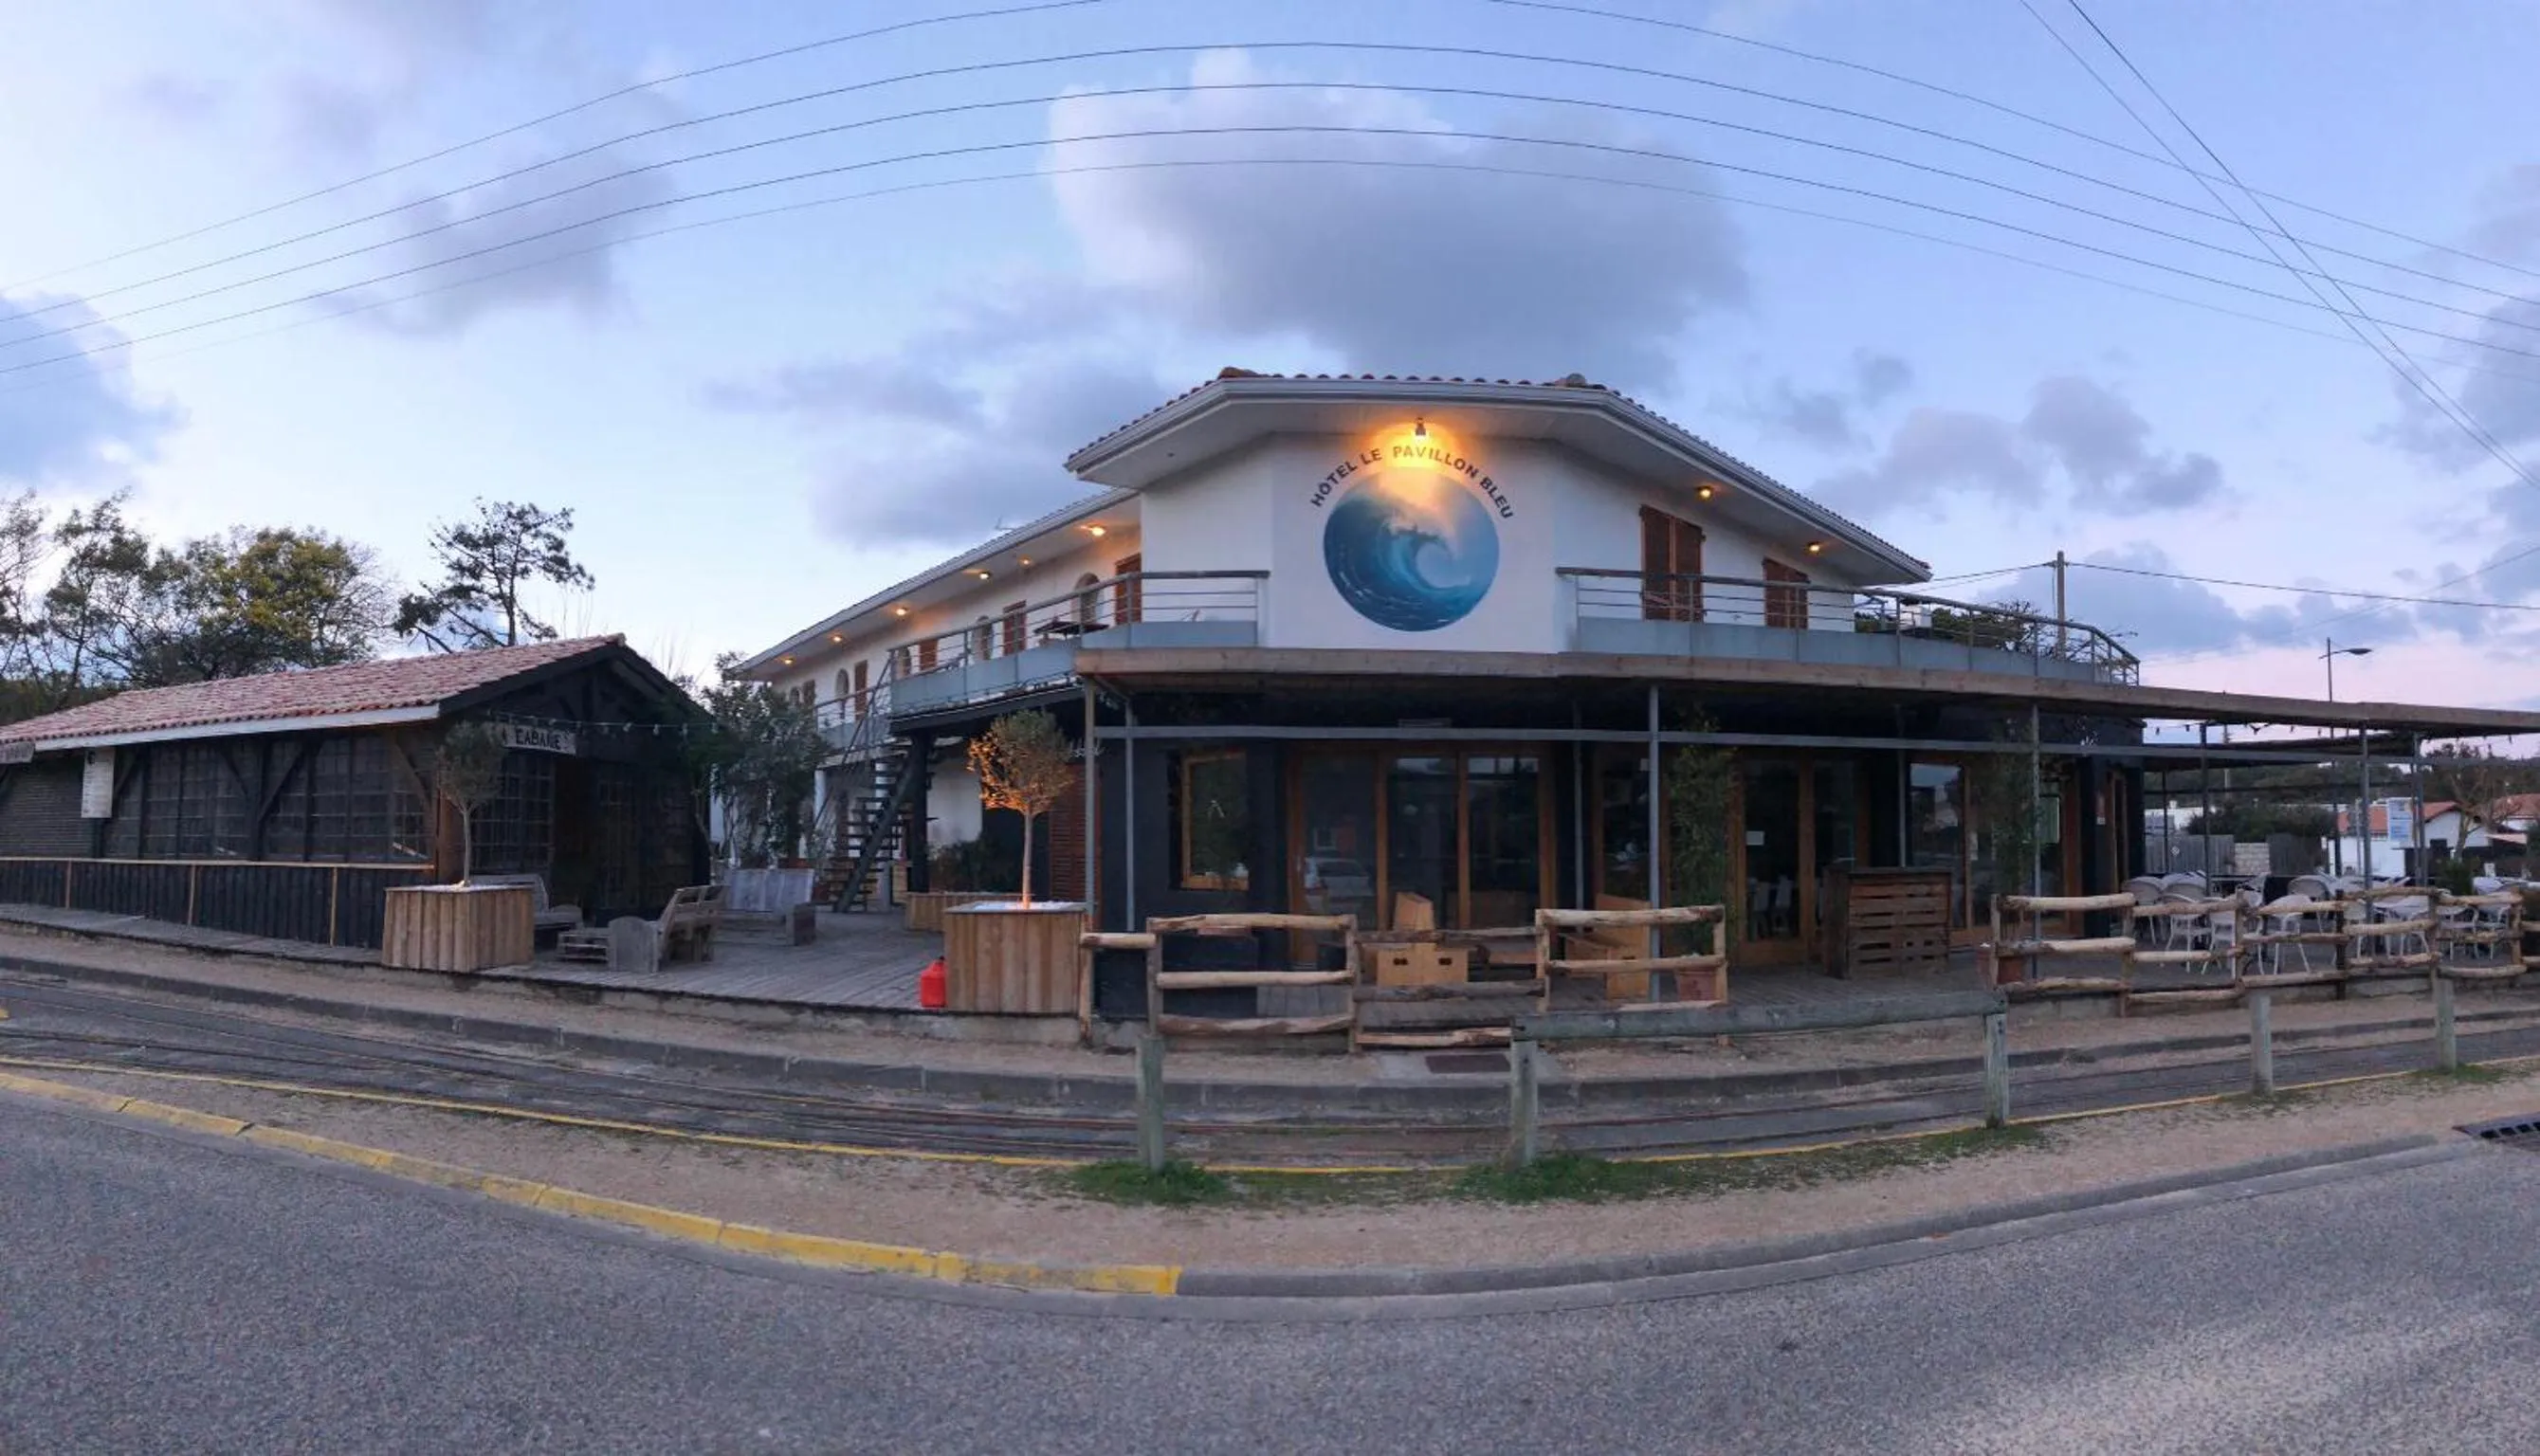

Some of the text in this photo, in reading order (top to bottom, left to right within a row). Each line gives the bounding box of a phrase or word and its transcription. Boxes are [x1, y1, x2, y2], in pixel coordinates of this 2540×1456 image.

[1359, 448, 1382, 464] LE
[1393, 446, 1479, 479] PAVILLON
[1480, 476, 1513, 519] BLEU
